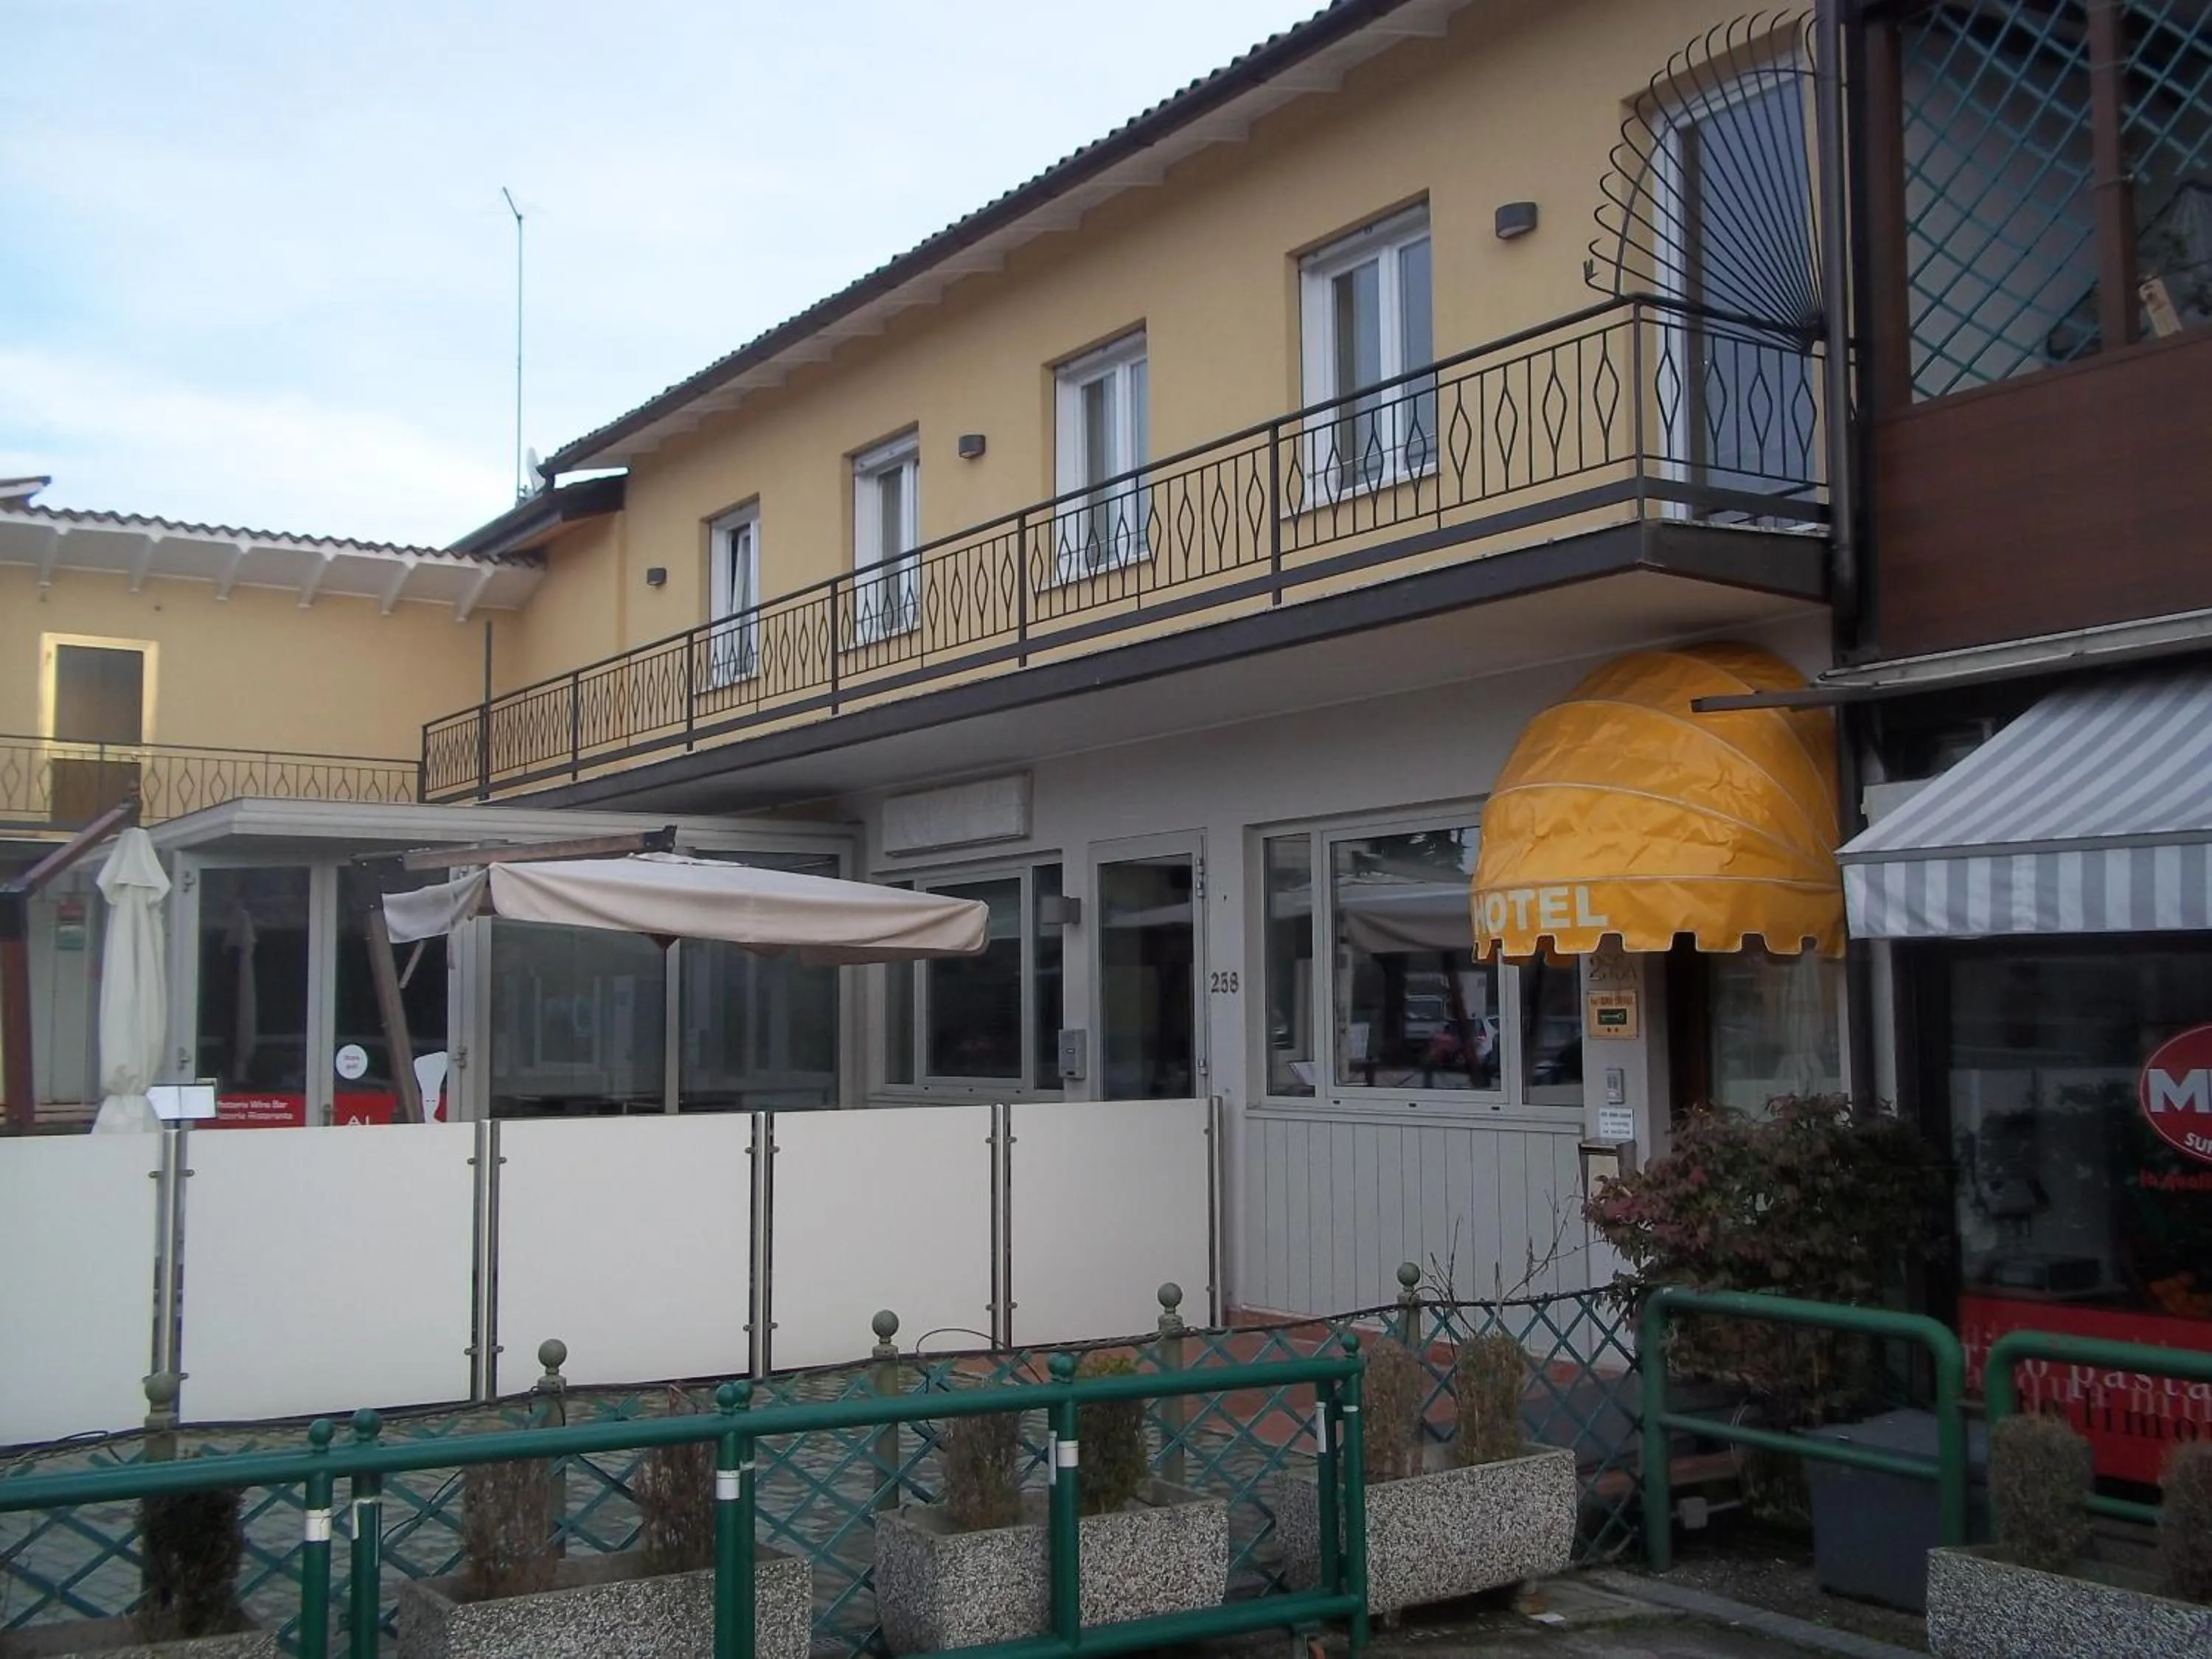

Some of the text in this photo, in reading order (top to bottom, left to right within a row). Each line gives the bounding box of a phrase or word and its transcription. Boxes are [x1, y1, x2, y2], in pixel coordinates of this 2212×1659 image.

[1473, 886, 1608, 934] HOTEL
[1211, 971, 1239, 993] 258
[2147, 1068, 2212, 1113] M
